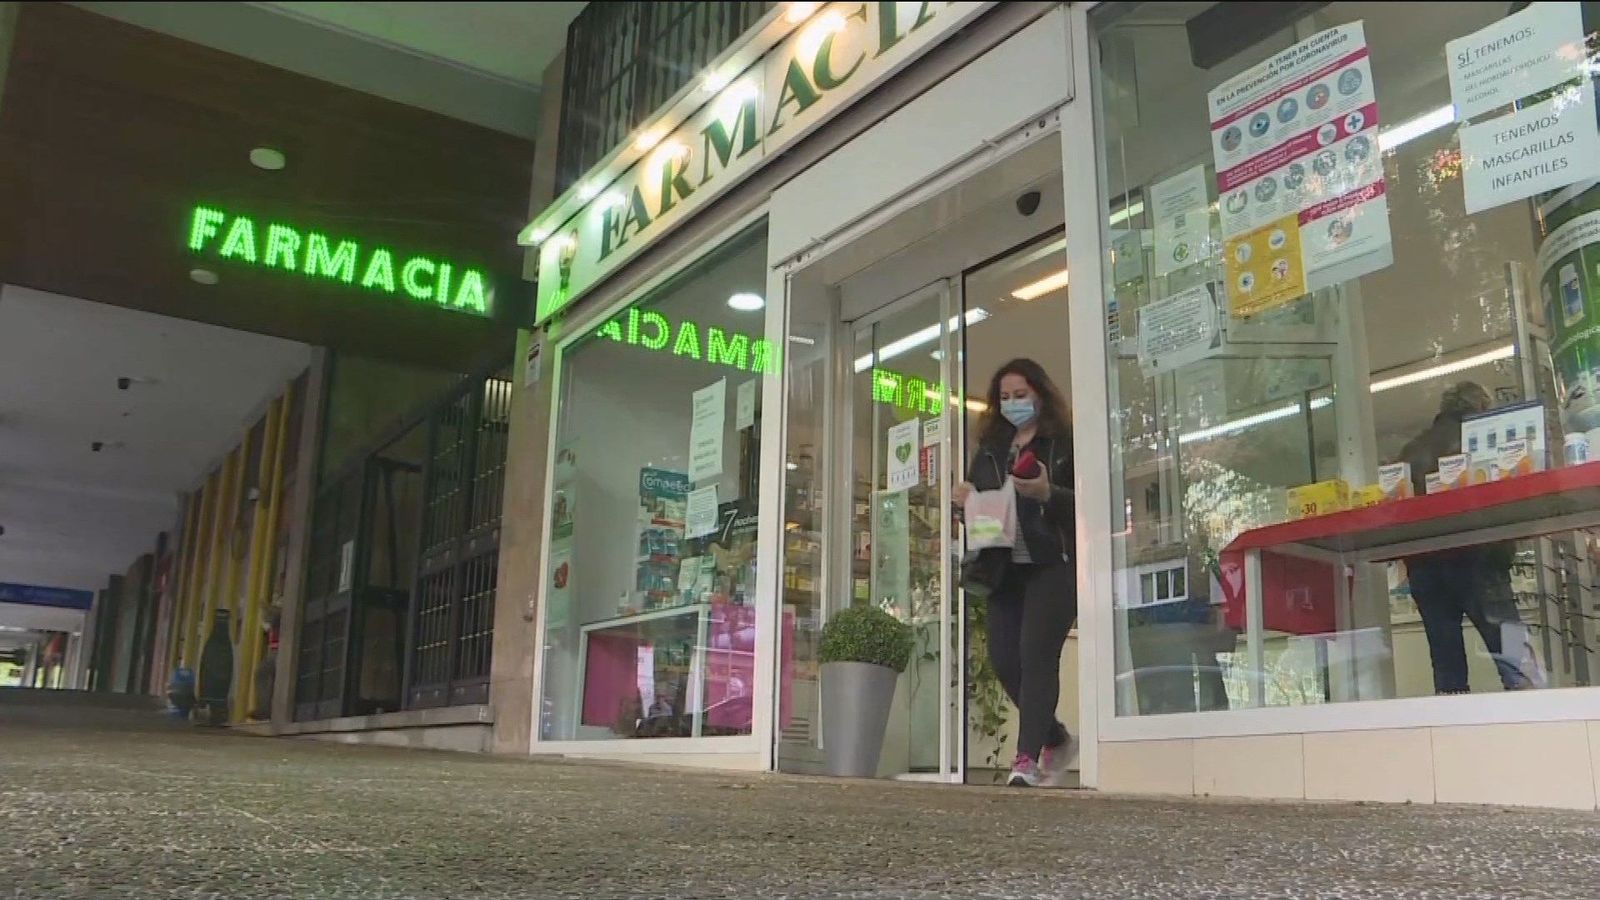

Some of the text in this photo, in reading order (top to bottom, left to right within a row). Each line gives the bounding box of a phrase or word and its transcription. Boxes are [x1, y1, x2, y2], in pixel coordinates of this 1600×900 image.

[1268, 28, 1339, 70] A TENER EN CUENTA
[1474, 26, 1536, 59] TENEMOS:
[1216, 95, 1226, 106] EN
[1226, 92, 1235, 101] LA
[1279, 62, 1295, 75] POR
[1296, 34, 1348, 64] CORONAVIRUS
[1493, 113, 1559, 146] TENEMOS
[1481, 131, 1575, 171] MASCARILLAS
[1491, 157, 1568, 191] INFANTILES
[188, 206, 486, 312] FARMACIA
